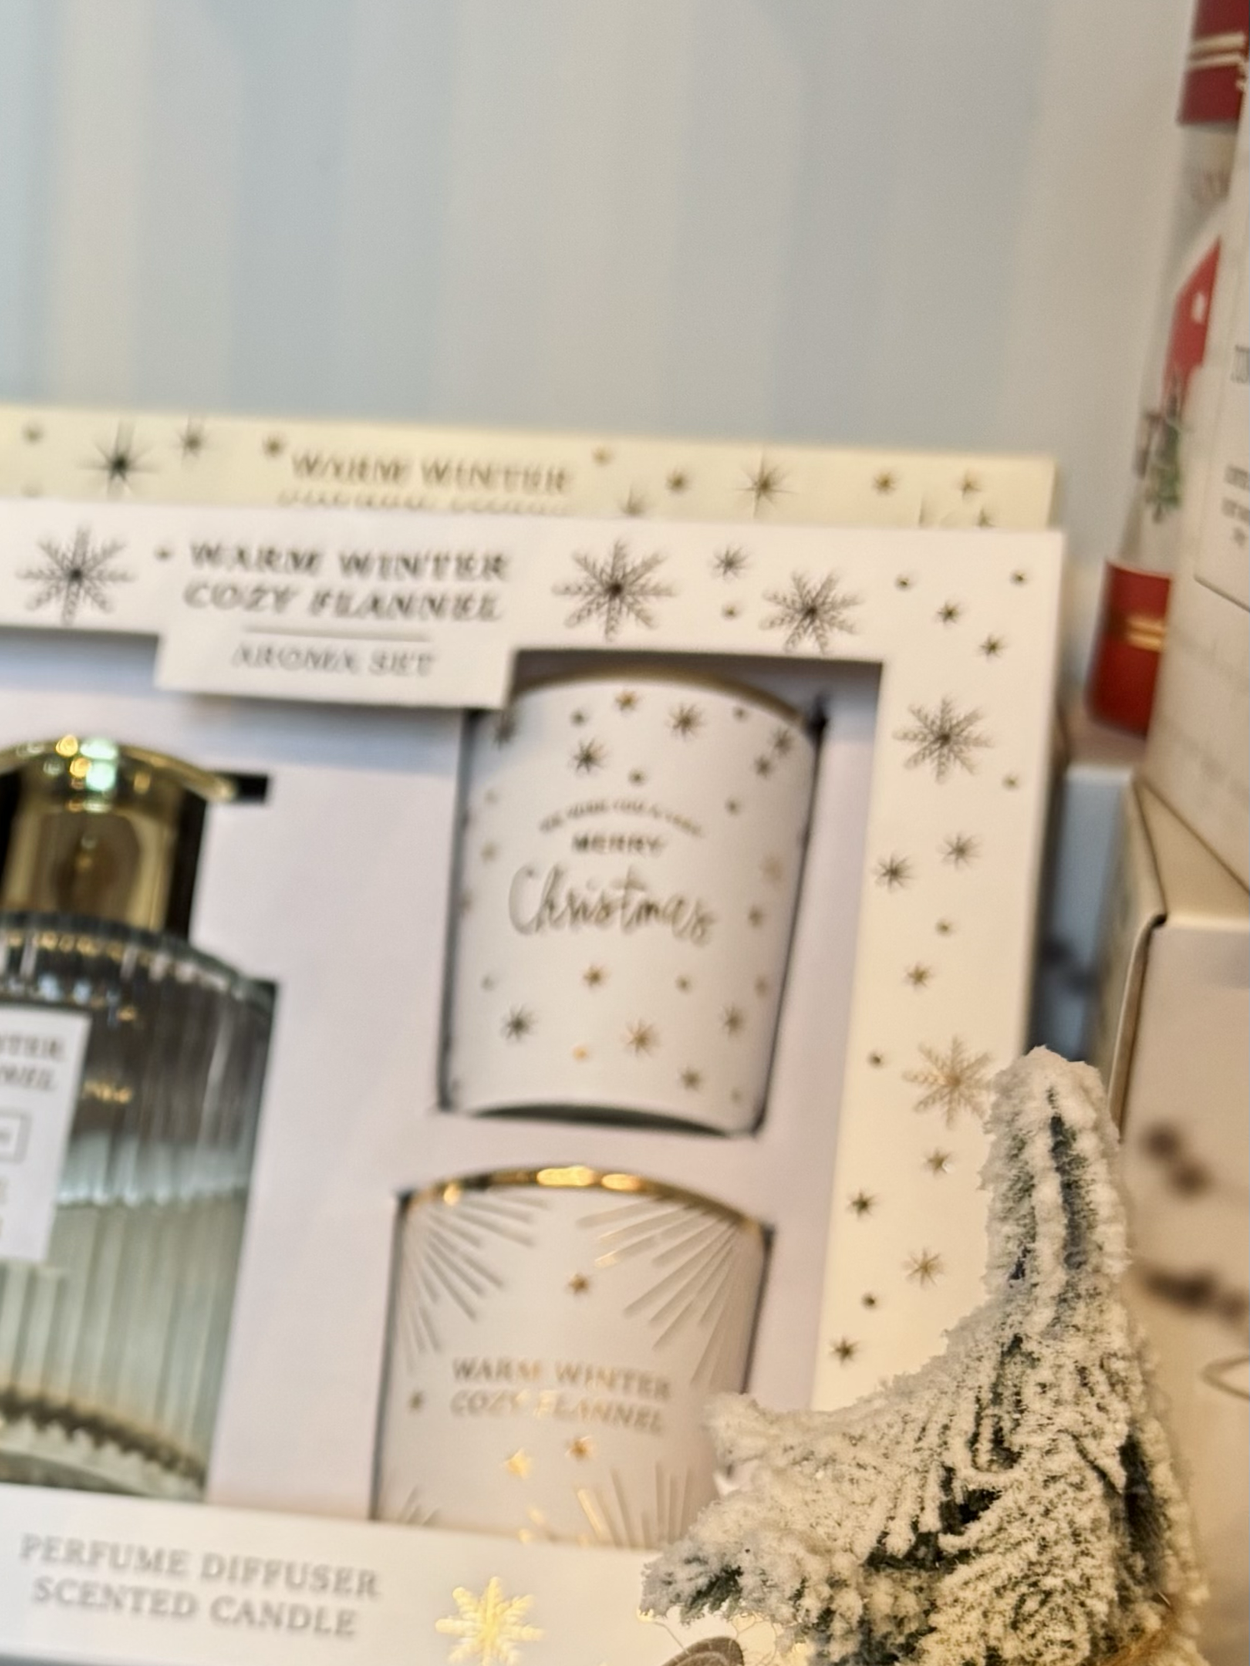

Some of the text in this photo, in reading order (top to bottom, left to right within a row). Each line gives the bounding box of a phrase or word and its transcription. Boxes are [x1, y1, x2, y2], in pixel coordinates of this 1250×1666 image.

[292, 451, 572, 493] WARM WINTER
[190, 542, 510, 581] WARM WINTER
[184, 582, 503, 623] COZY FLANNEL
[232, 644, 435, 677] AROMA SET
[508, 864, 716, 948] Christmas
[452, 1357, 671, 1399] WARM WINTER
[21, 1533, 380, 1598] PERFUME DIFFUSER
[32, 1577, 358, 1637] SCENTED CANDLE
